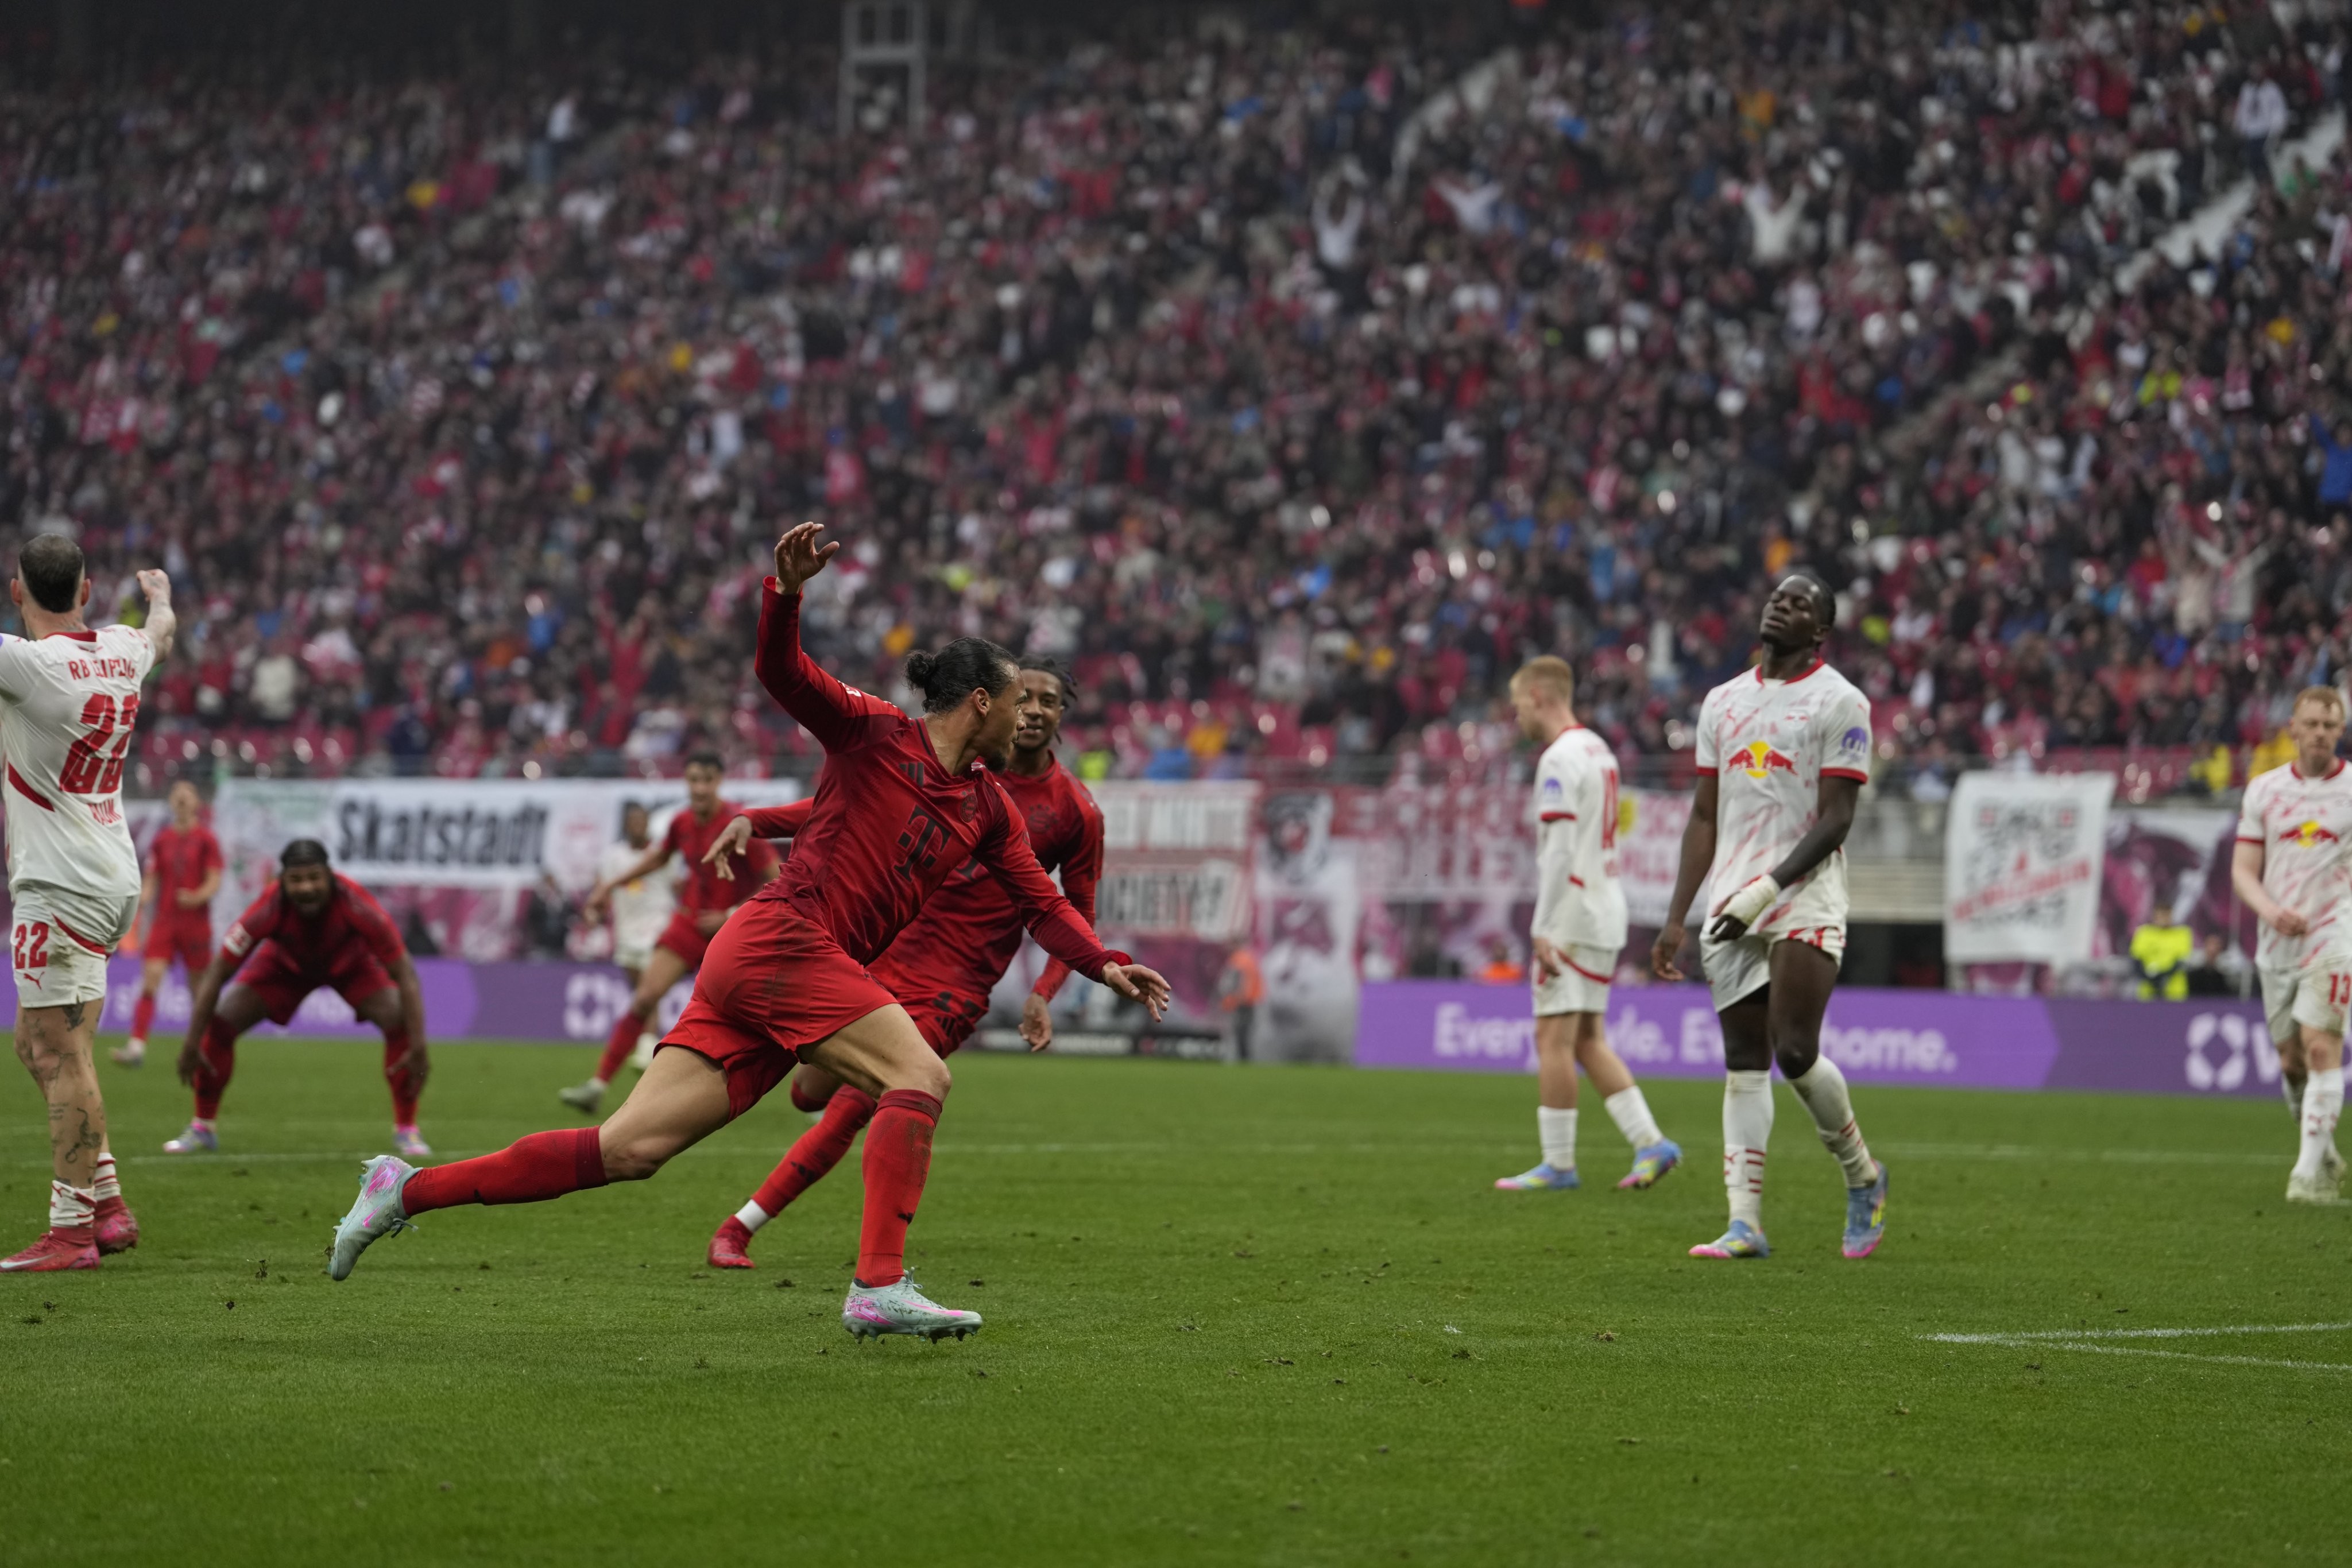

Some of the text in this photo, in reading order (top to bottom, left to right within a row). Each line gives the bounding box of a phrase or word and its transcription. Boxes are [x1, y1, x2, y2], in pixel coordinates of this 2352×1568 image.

[69, 659, 90, 680] RB
[59, 692, 140, 793] 22
[339, 798, 550, 864] Skatstadt
[15, 922, 49, 969] 22
[2330, 973, 2351, 1005] 13
